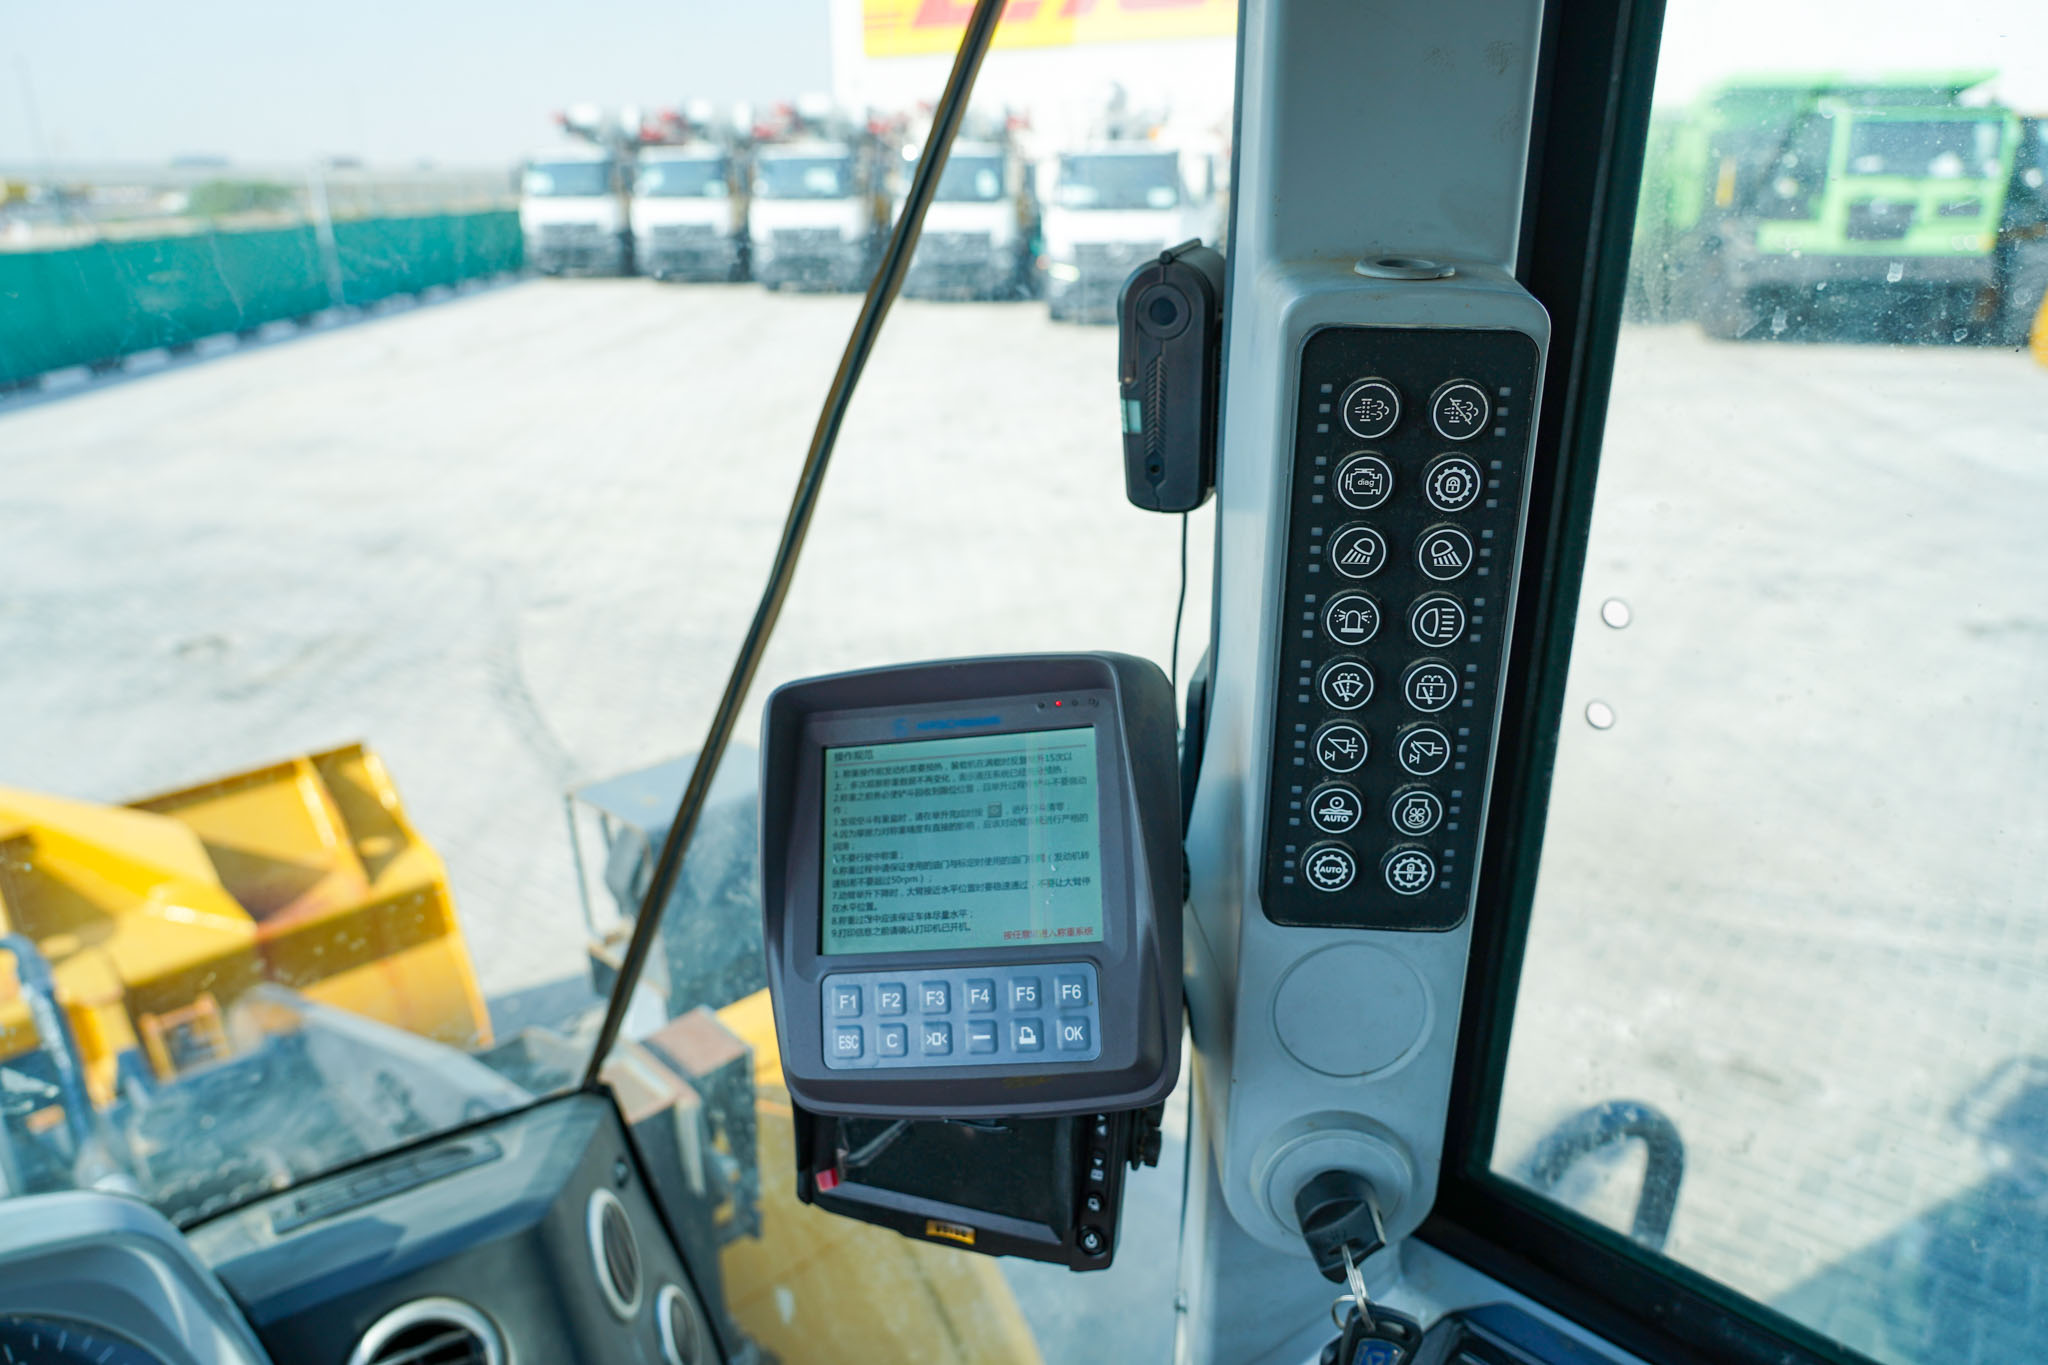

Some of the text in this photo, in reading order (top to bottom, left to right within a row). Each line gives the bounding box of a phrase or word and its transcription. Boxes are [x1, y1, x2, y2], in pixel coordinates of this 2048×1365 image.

[1357, 477, 1375, 488] diag
[1323, 814, 1349, 823] AUTO
[1320, 866, 1343, 875] AUTO
[1002, 924, 1094, 941] 按任意进入称重系统
[926, 991, 945, 1006] F3
[971, 989, 990, 1004] F4
[1016, 987, 1035, 1002] F5
[1062, 984, 1082, 1000] F6
[840, 995, 857, 1010] F1
[882, 993, 901, 1008] F2
[886, 1034, 898, 1048] C
[1065, 1026, 1084, 1041] OK
[839, 1035, 859, 1050] ESC
